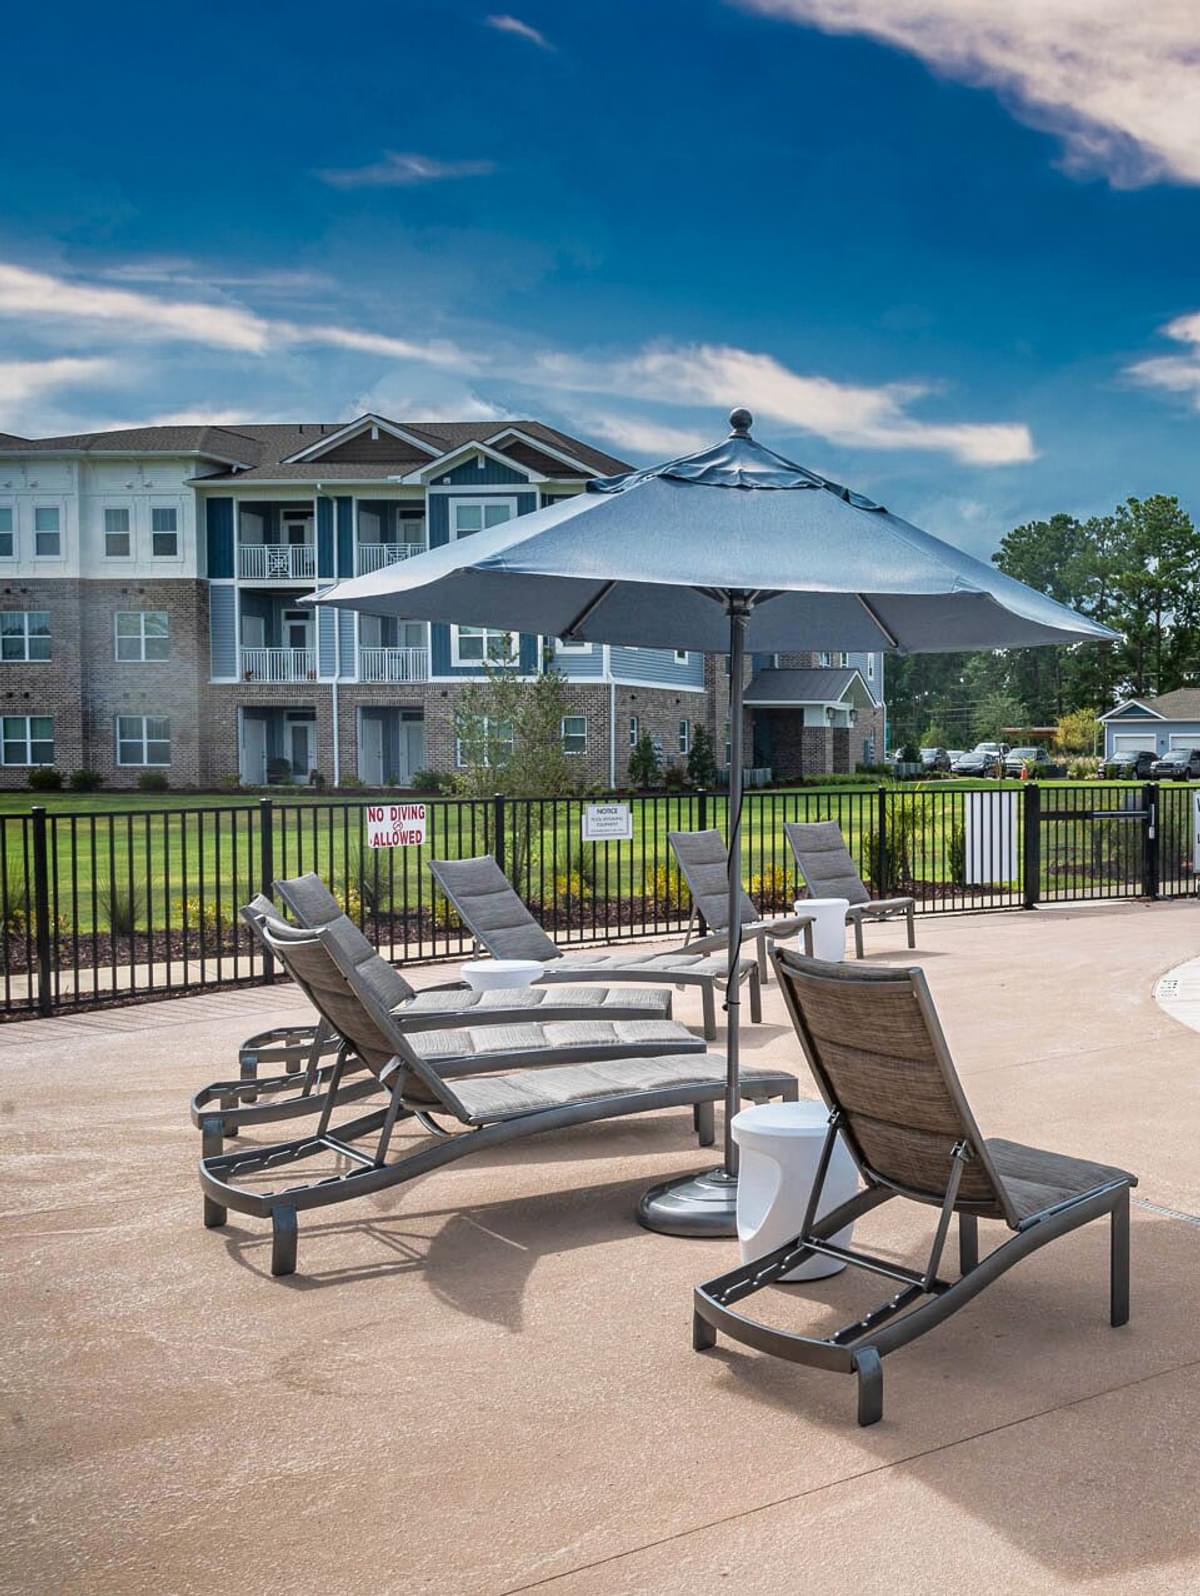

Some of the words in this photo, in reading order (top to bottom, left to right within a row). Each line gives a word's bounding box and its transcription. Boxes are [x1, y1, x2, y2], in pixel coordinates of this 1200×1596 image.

[368, 807, 384, 822] NO
[390, 805, 425, 821] DIVING
[373, 830, 422, 847] ALLOWED
